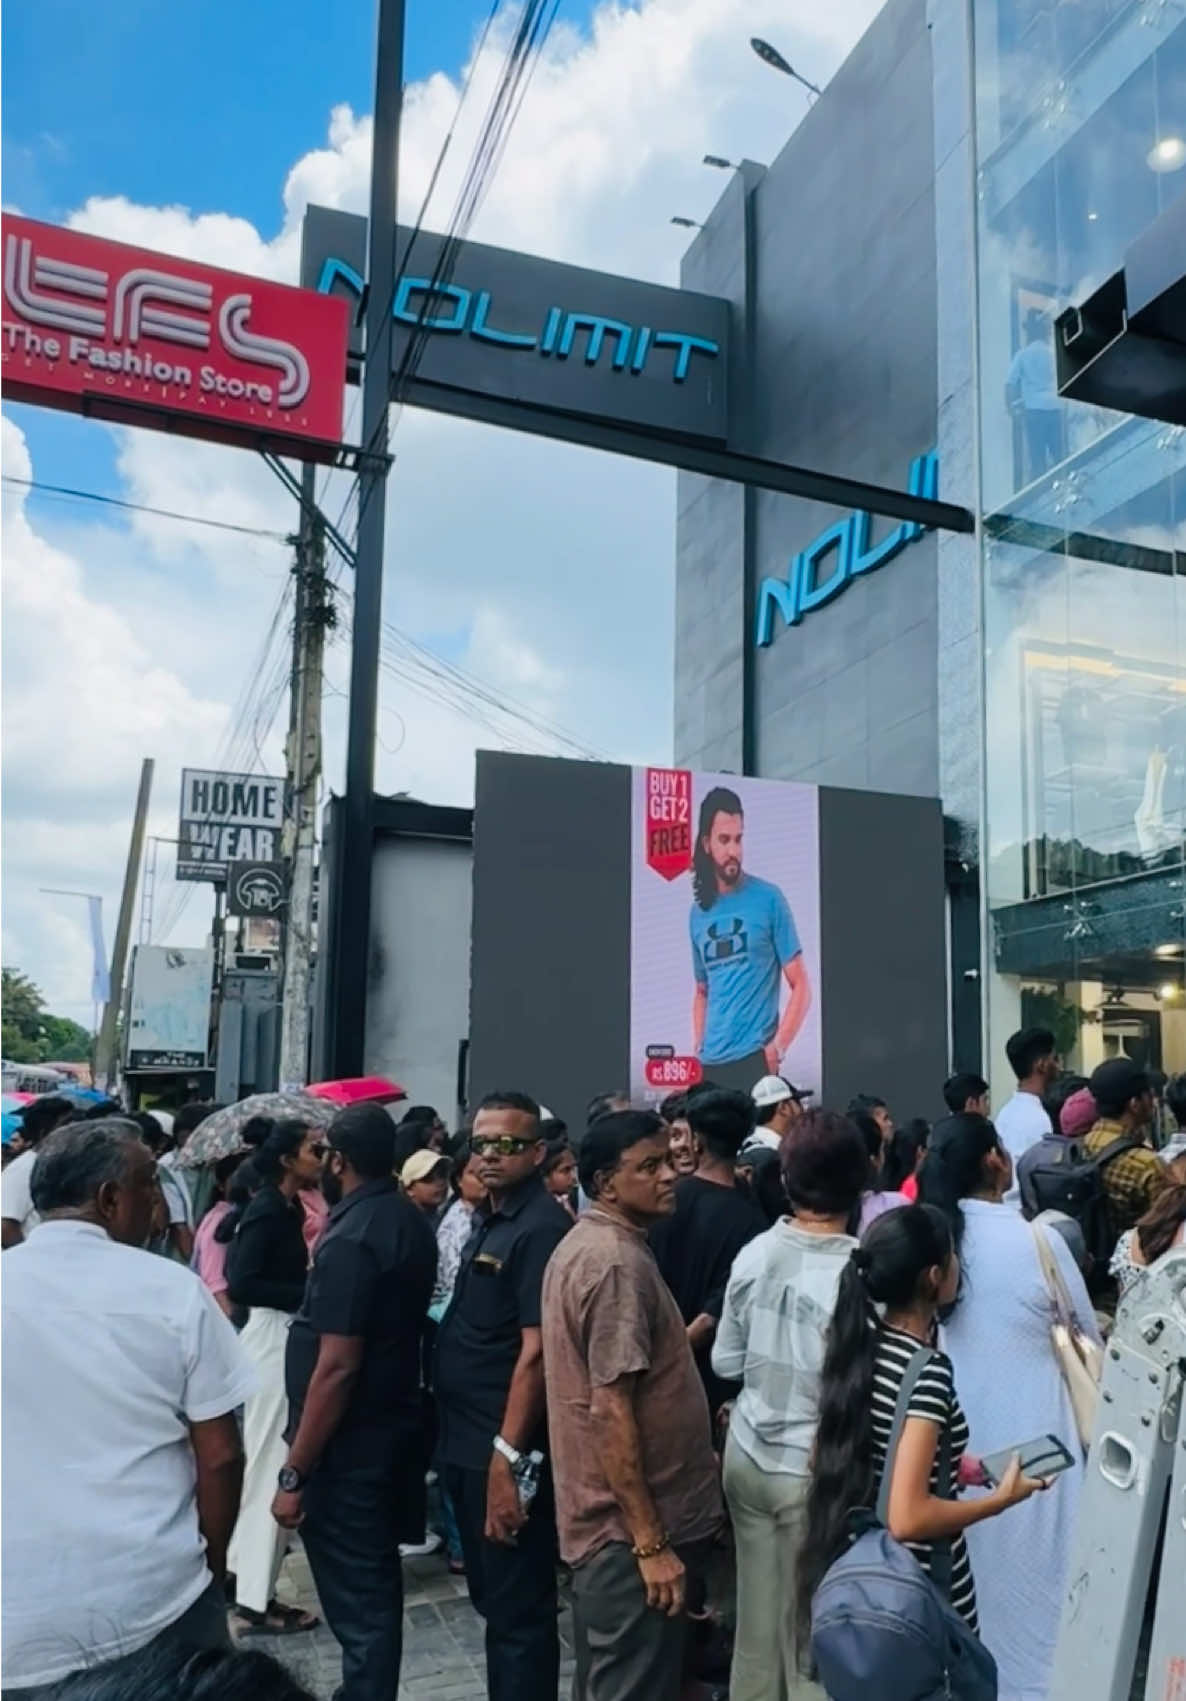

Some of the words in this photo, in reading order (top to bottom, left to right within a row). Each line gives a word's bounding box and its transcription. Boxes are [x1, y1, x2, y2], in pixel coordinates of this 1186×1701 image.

[3, 321, 61, 358] The
[68, 335, 192, 385] Fashion
[200, 365, 273, 403] Store
[757, 449, 938, 647] NOLI
[191, 779, 277, 819] HOME
[650, 771, 678, 796] BUY
[680, 774, 688, 797] 1
[650, 795, 677, 821] GET
[678, 797, 689, 822] 2
[189, 823, 274, 861] WEAR
[650, 823, 689, 856] FREE
